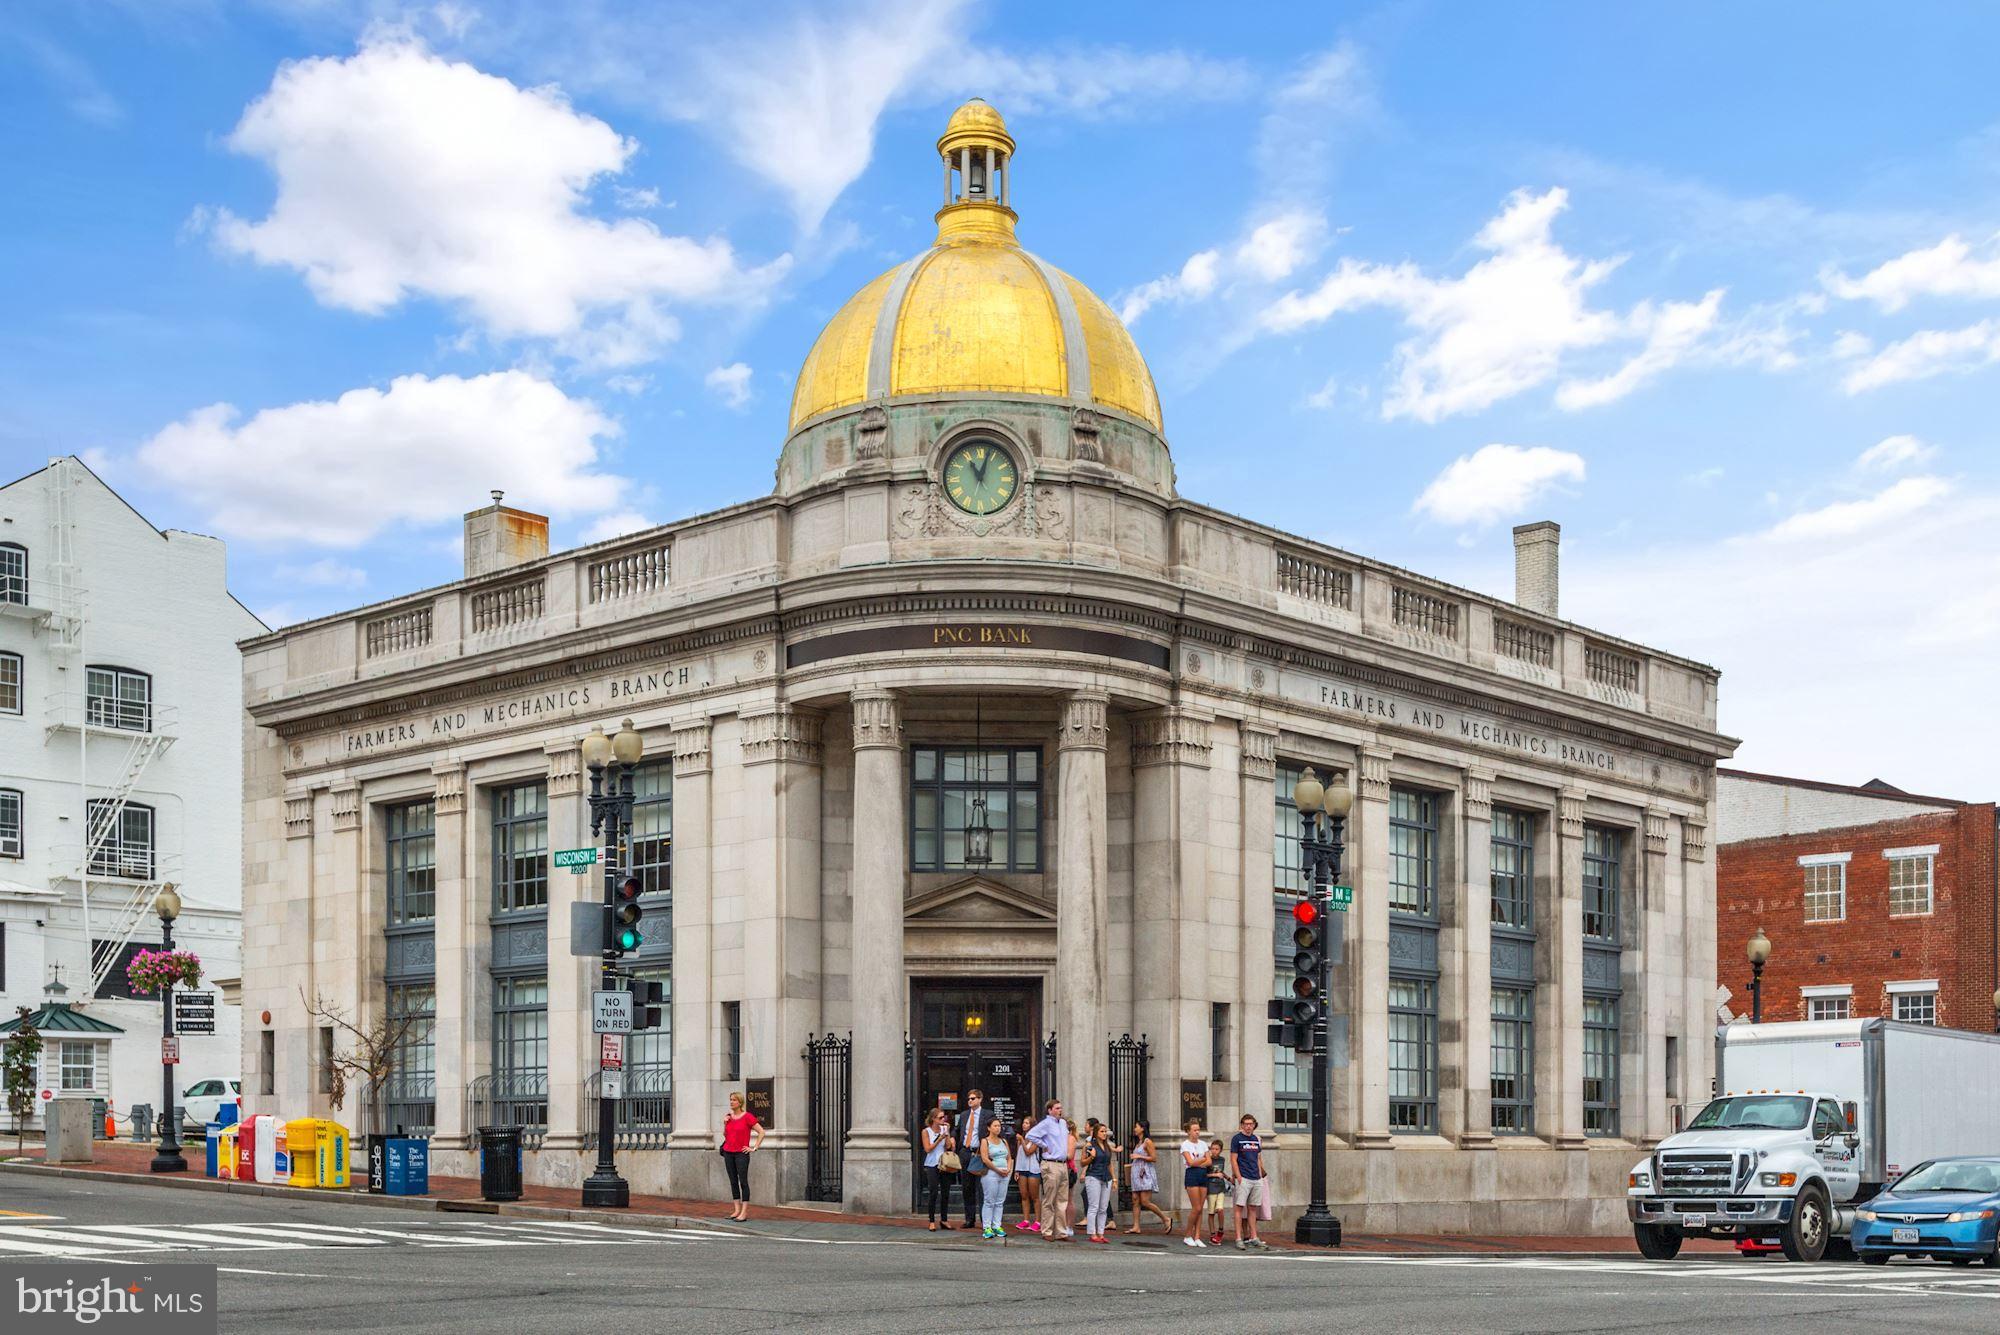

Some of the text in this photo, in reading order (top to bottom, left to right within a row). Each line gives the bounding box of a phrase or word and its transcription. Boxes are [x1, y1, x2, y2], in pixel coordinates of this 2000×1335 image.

[933, 627, 1032, 643] PNC BANK
[348, 667, 689, 751] FARMERS AND MECHANICS BRANCH
[1321, 686, 1615, 770] FARMERS AND MECHANICS BRANCH
[556, 851, 590, 865] WISCONSIN
[572, 865, 587, 874] 1200
[1336, 888, 1343, 900] M
[1331, 901, 1347, 911] 3100
[605, 998, 620, 1006] NO
[601, 1009, 626, 1017] TURN
[596, 1020, 630, 1028] ON RED
[755, 1092, 768, 1100] PNC
[1190, 1093, 1202, 1101] PNC
[1190, 1101, 1205, 1109] BANK
[371, 1145, 382, 1189] blade
